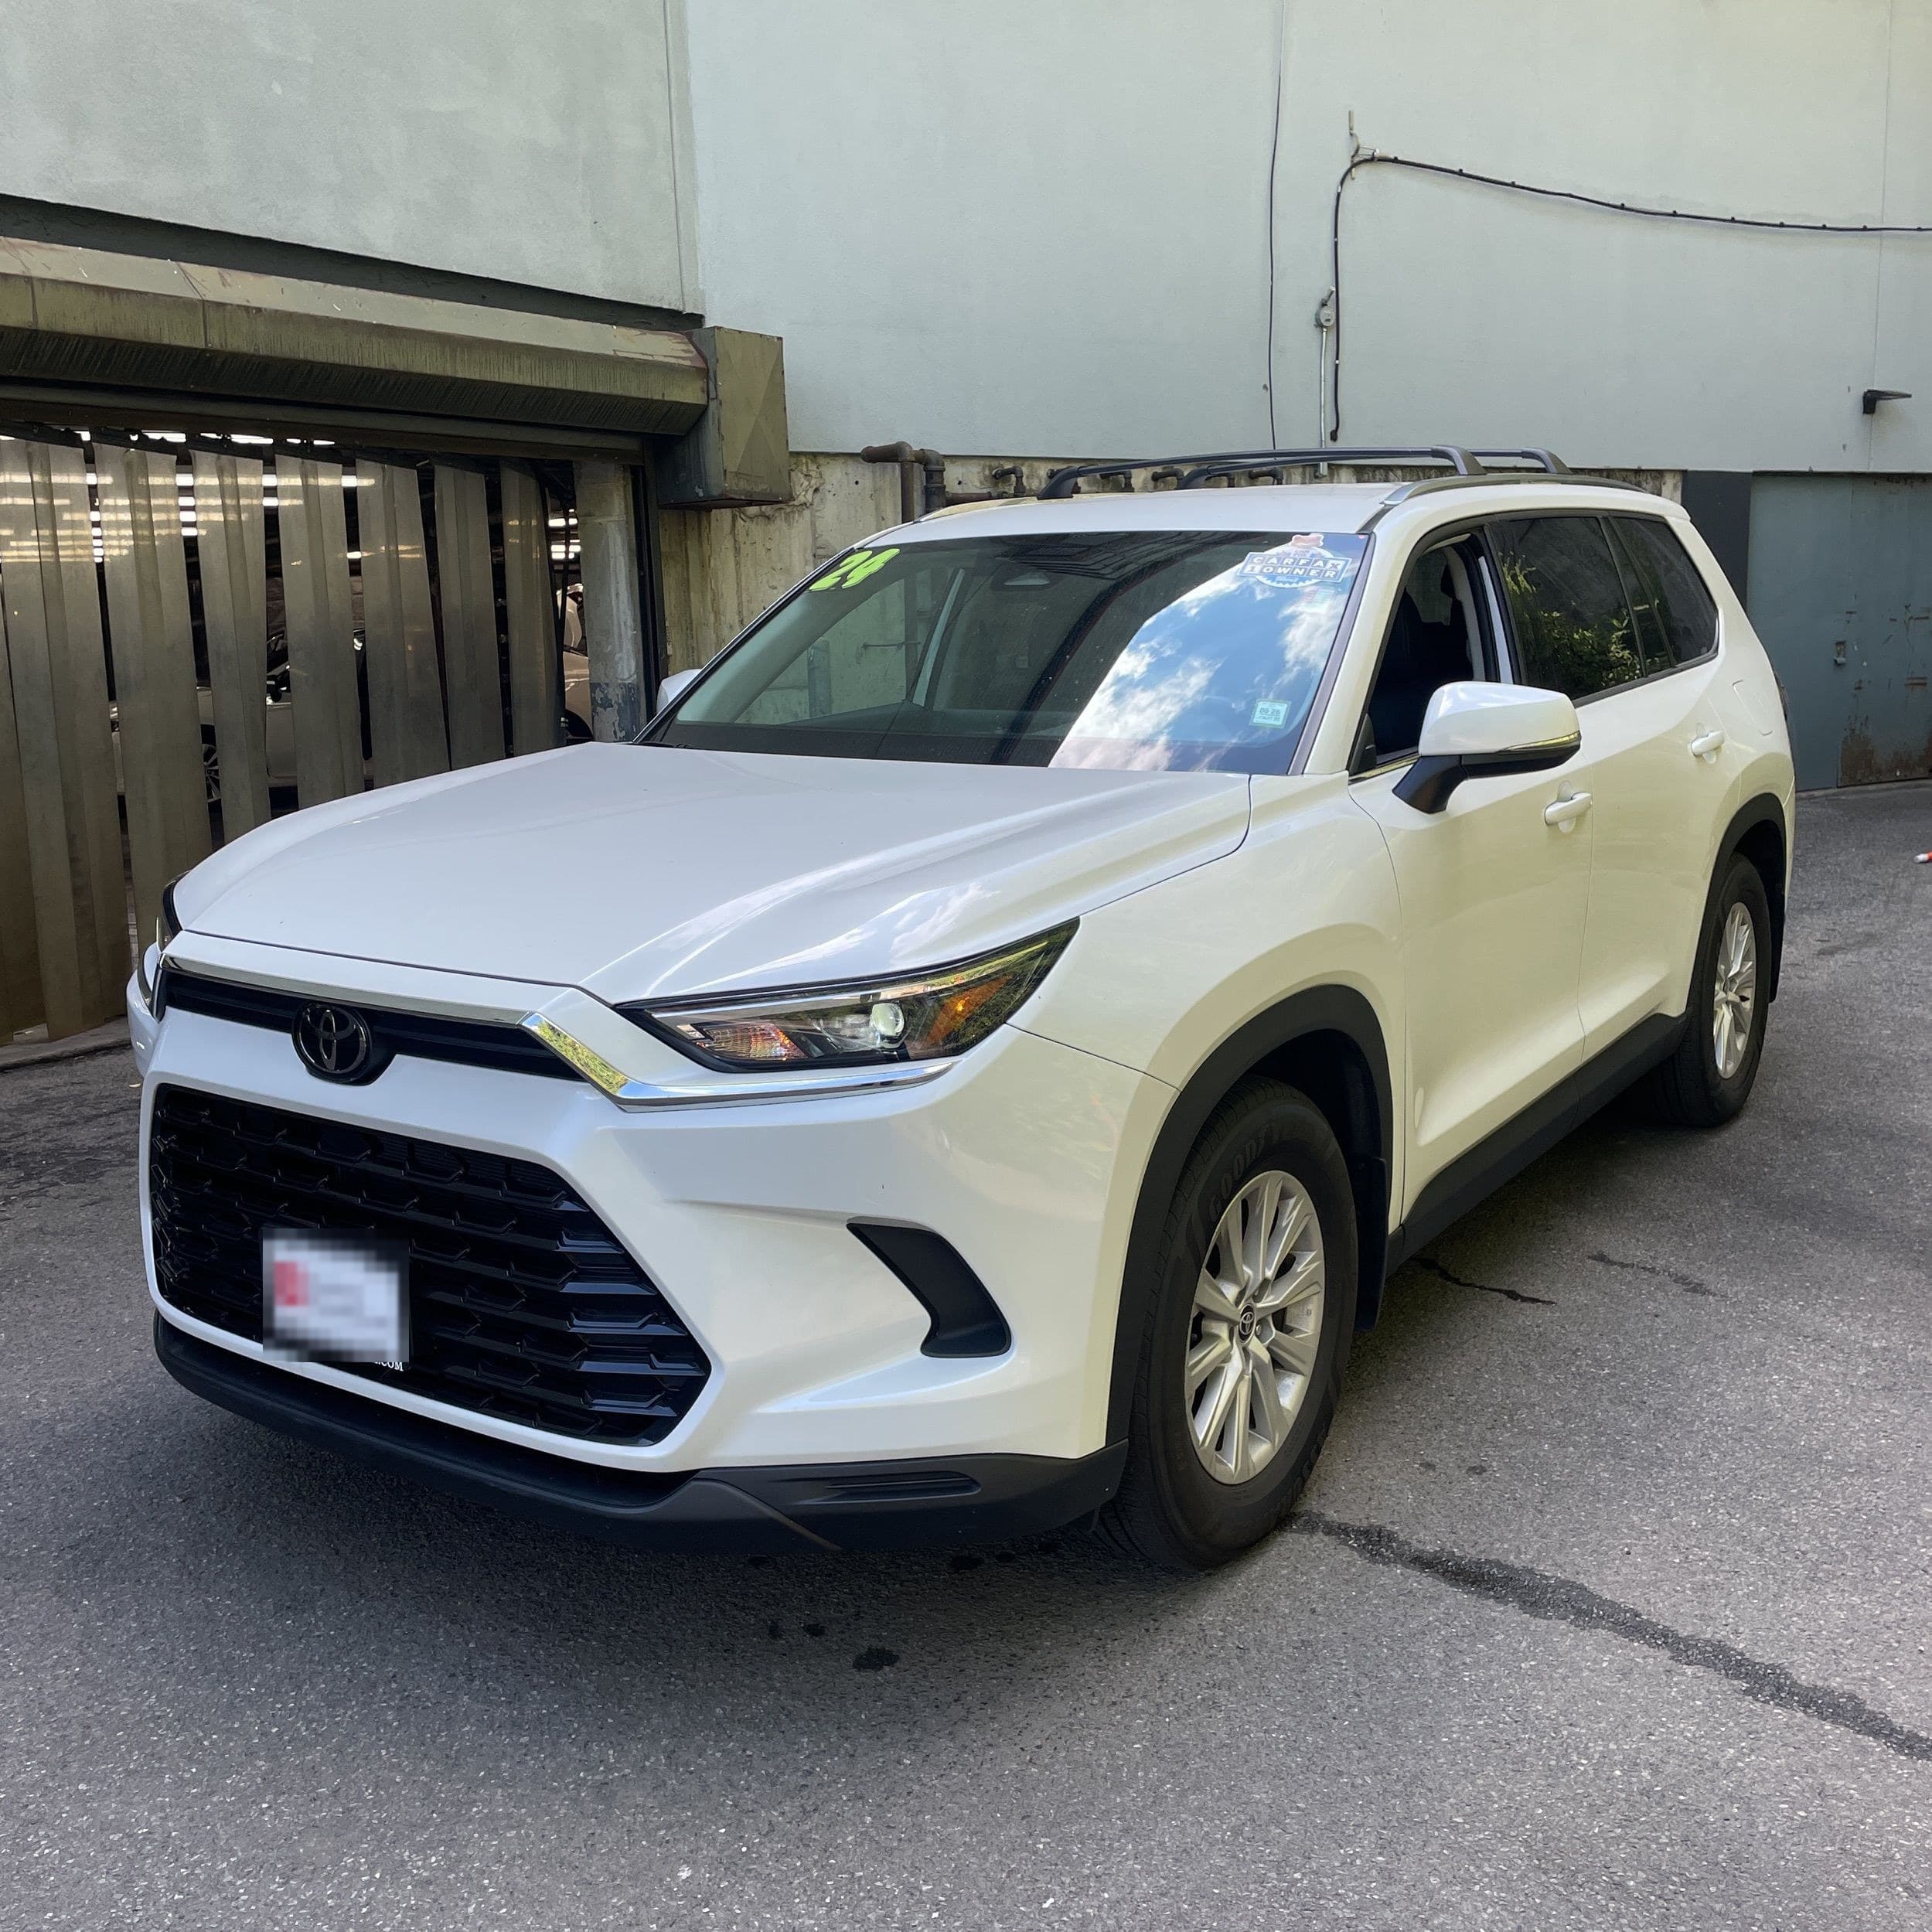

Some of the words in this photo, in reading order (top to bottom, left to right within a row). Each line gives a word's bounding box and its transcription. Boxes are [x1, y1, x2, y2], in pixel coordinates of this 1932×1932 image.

[809, 548, 900, 591] 24
[1252, 556, 1342, 570] CARFAX
[1262, 566, 1337, 578] OWNER
